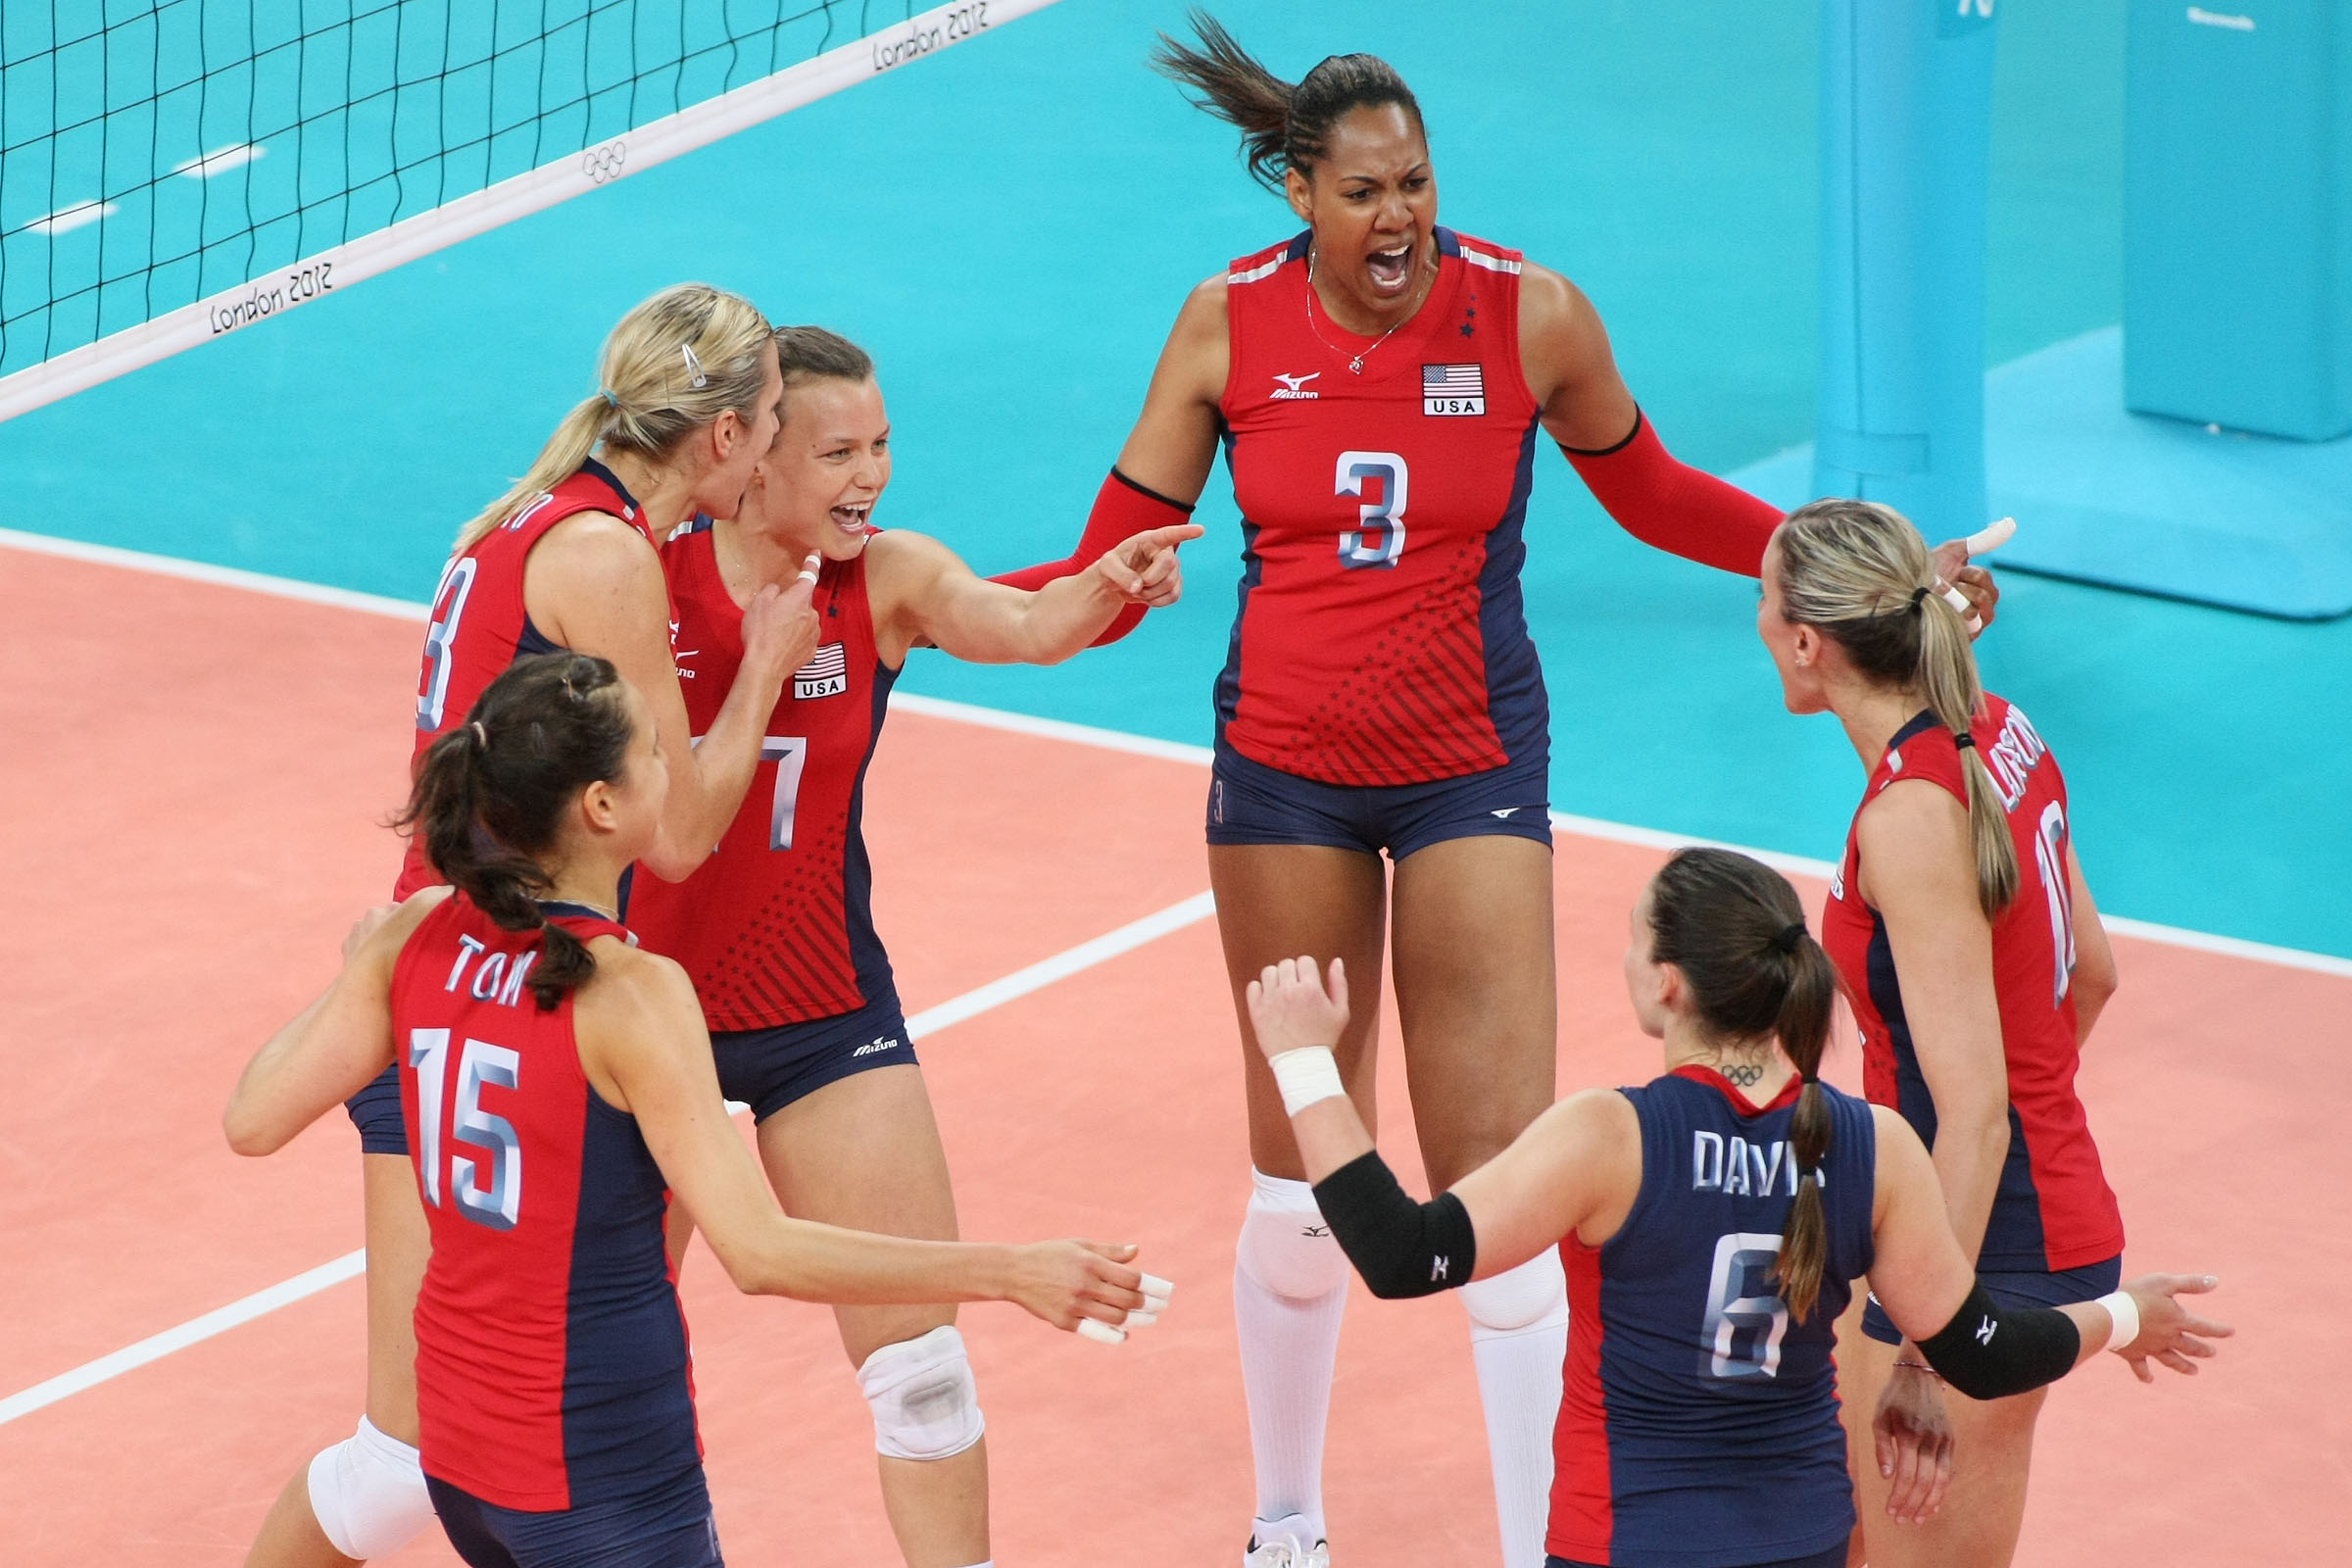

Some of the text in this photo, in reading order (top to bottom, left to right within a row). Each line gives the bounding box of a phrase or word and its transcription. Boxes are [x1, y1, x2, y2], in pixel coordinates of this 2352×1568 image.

[872, 1, 988, 71] London 2012
[210, 263, 332, 334] London 2012
[1433, 400, 1476, 414] USA
[1334, 450, 1408, 570] 3
[803, 679, 839, 696] USA
[444, 933, 538, 1007] TOM
[409, 1027, 522, 1232] 15
[1701, 1232, 1790, 1378] 6
